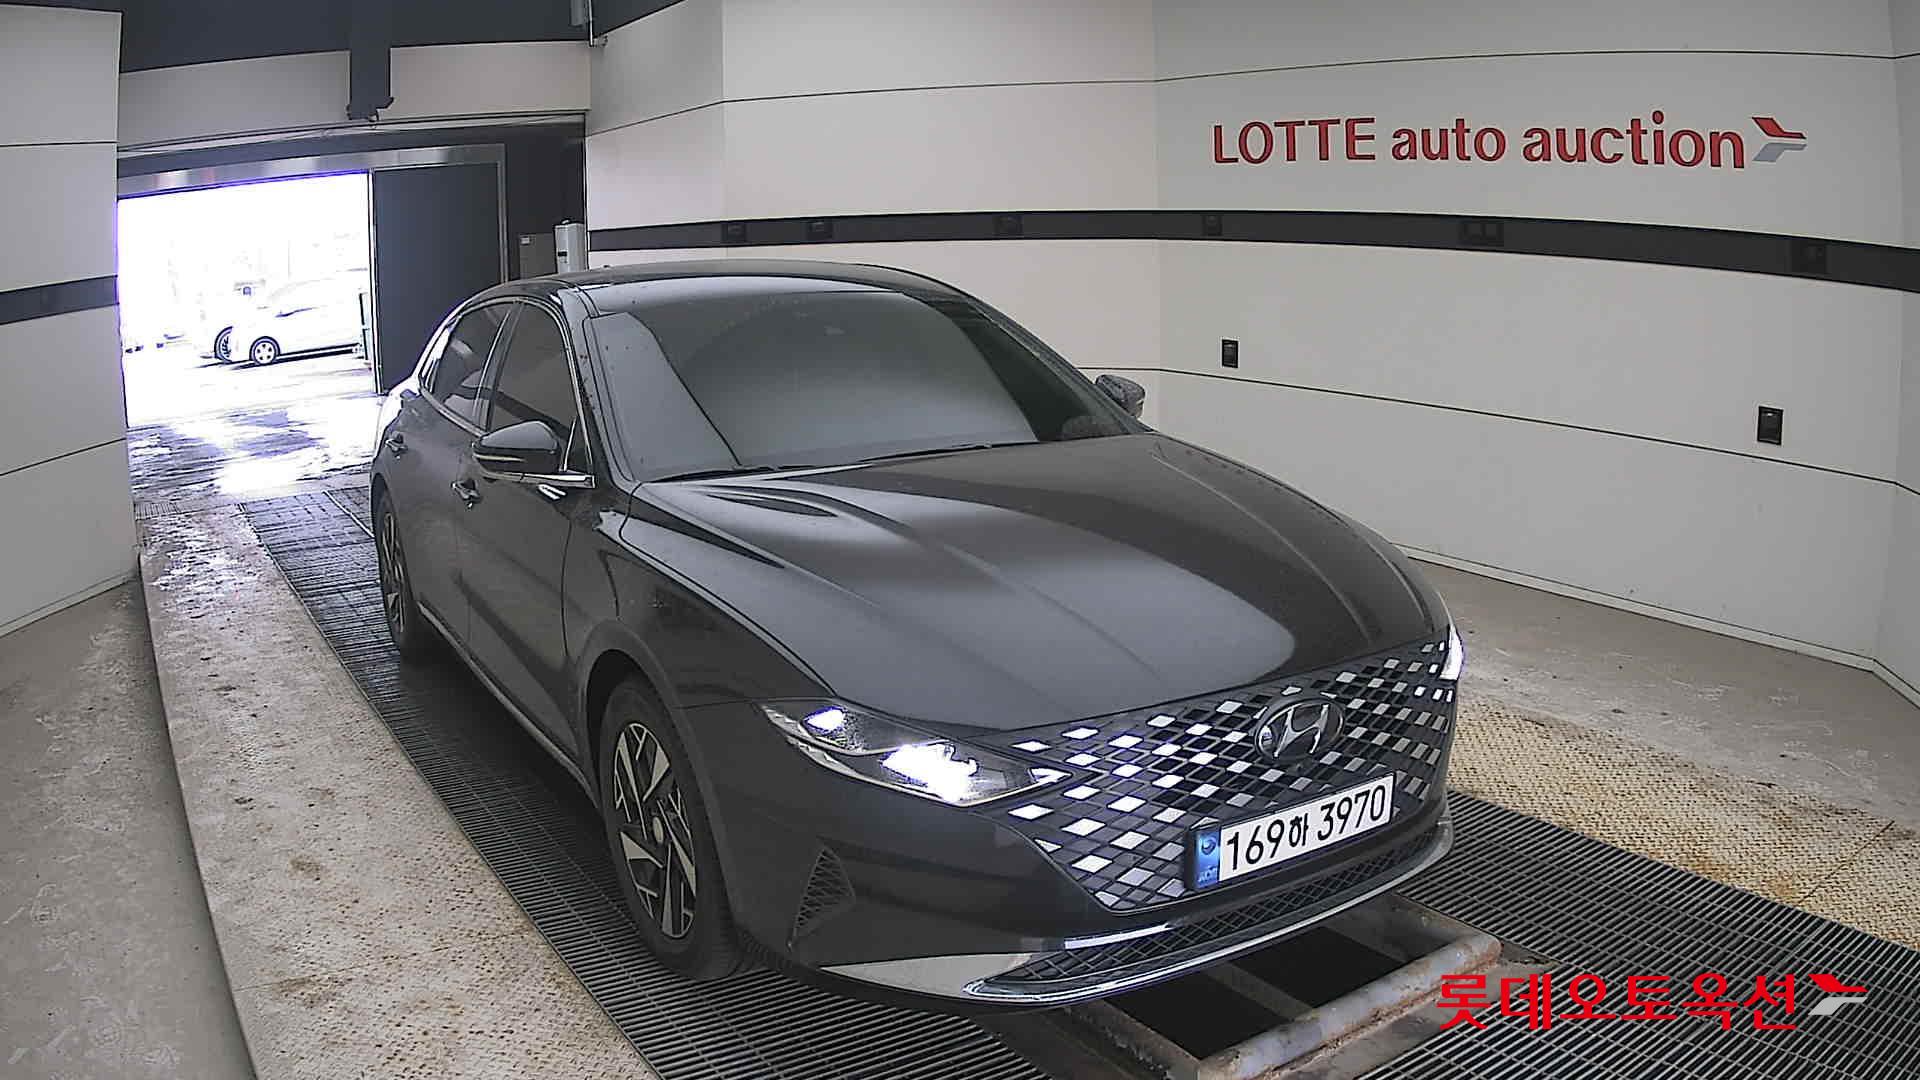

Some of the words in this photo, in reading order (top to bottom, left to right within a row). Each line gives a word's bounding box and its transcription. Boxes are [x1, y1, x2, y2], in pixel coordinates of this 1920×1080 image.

[1213, 117, 1376, 165] LOTTE
[1391, 117, 1507, 162] auto
[1522, 109, 1744, 169] auction
[1226, 813, 1309, 870] 169하
[1317, 785, 1386, 841] 3970
